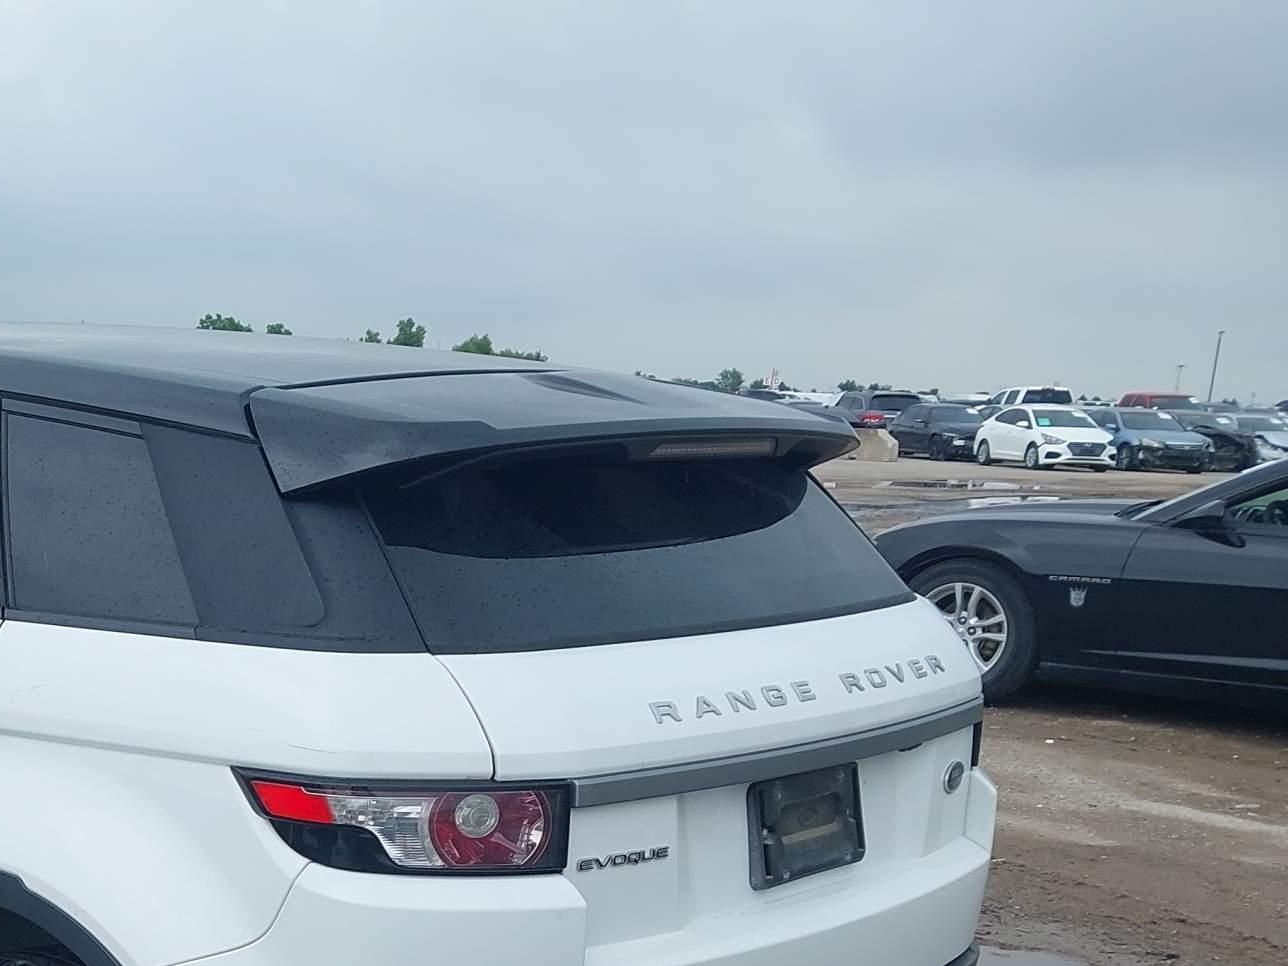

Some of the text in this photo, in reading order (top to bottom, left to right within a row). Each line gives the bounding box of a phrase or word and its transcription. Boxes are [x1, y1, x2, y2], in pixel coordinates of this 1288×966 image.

[1048, 575, 1112, 584] CAMARO
[648, 654, 946, 724] RANGE ROVER
[576, 846, 670, 872] EVOQUE
